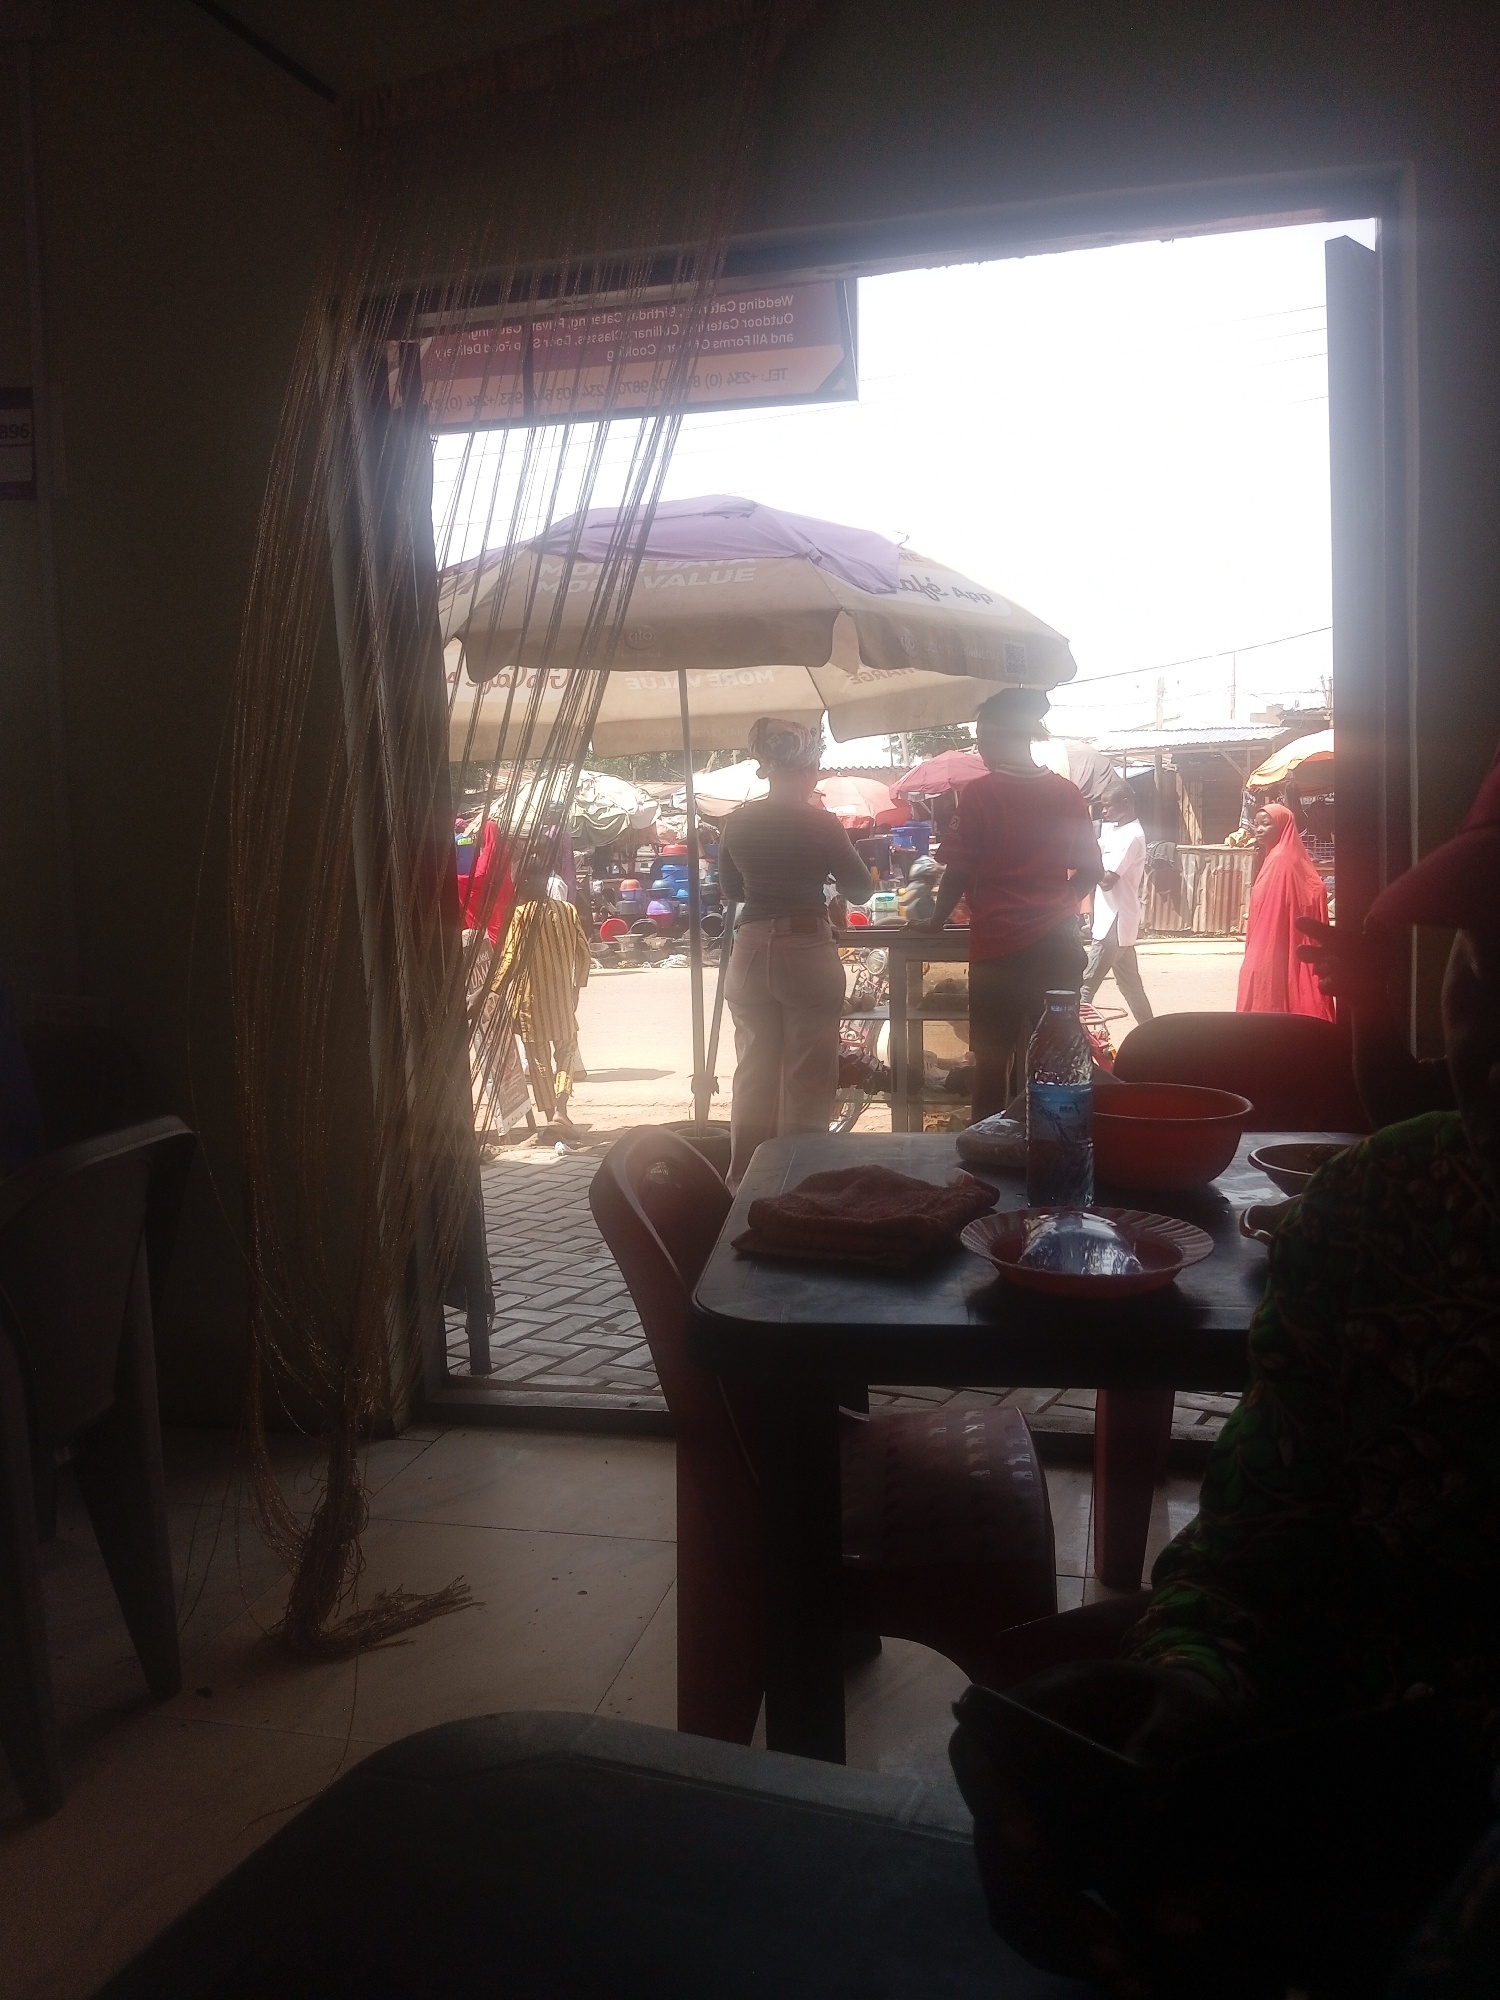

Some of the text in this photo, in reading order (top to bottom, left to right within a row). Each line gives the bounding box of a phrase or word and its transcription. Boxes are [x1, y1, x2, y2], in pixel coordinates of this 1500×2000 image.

[642, 567, 757, 590] VALUE
[896, 574, 994, 605] afé App
